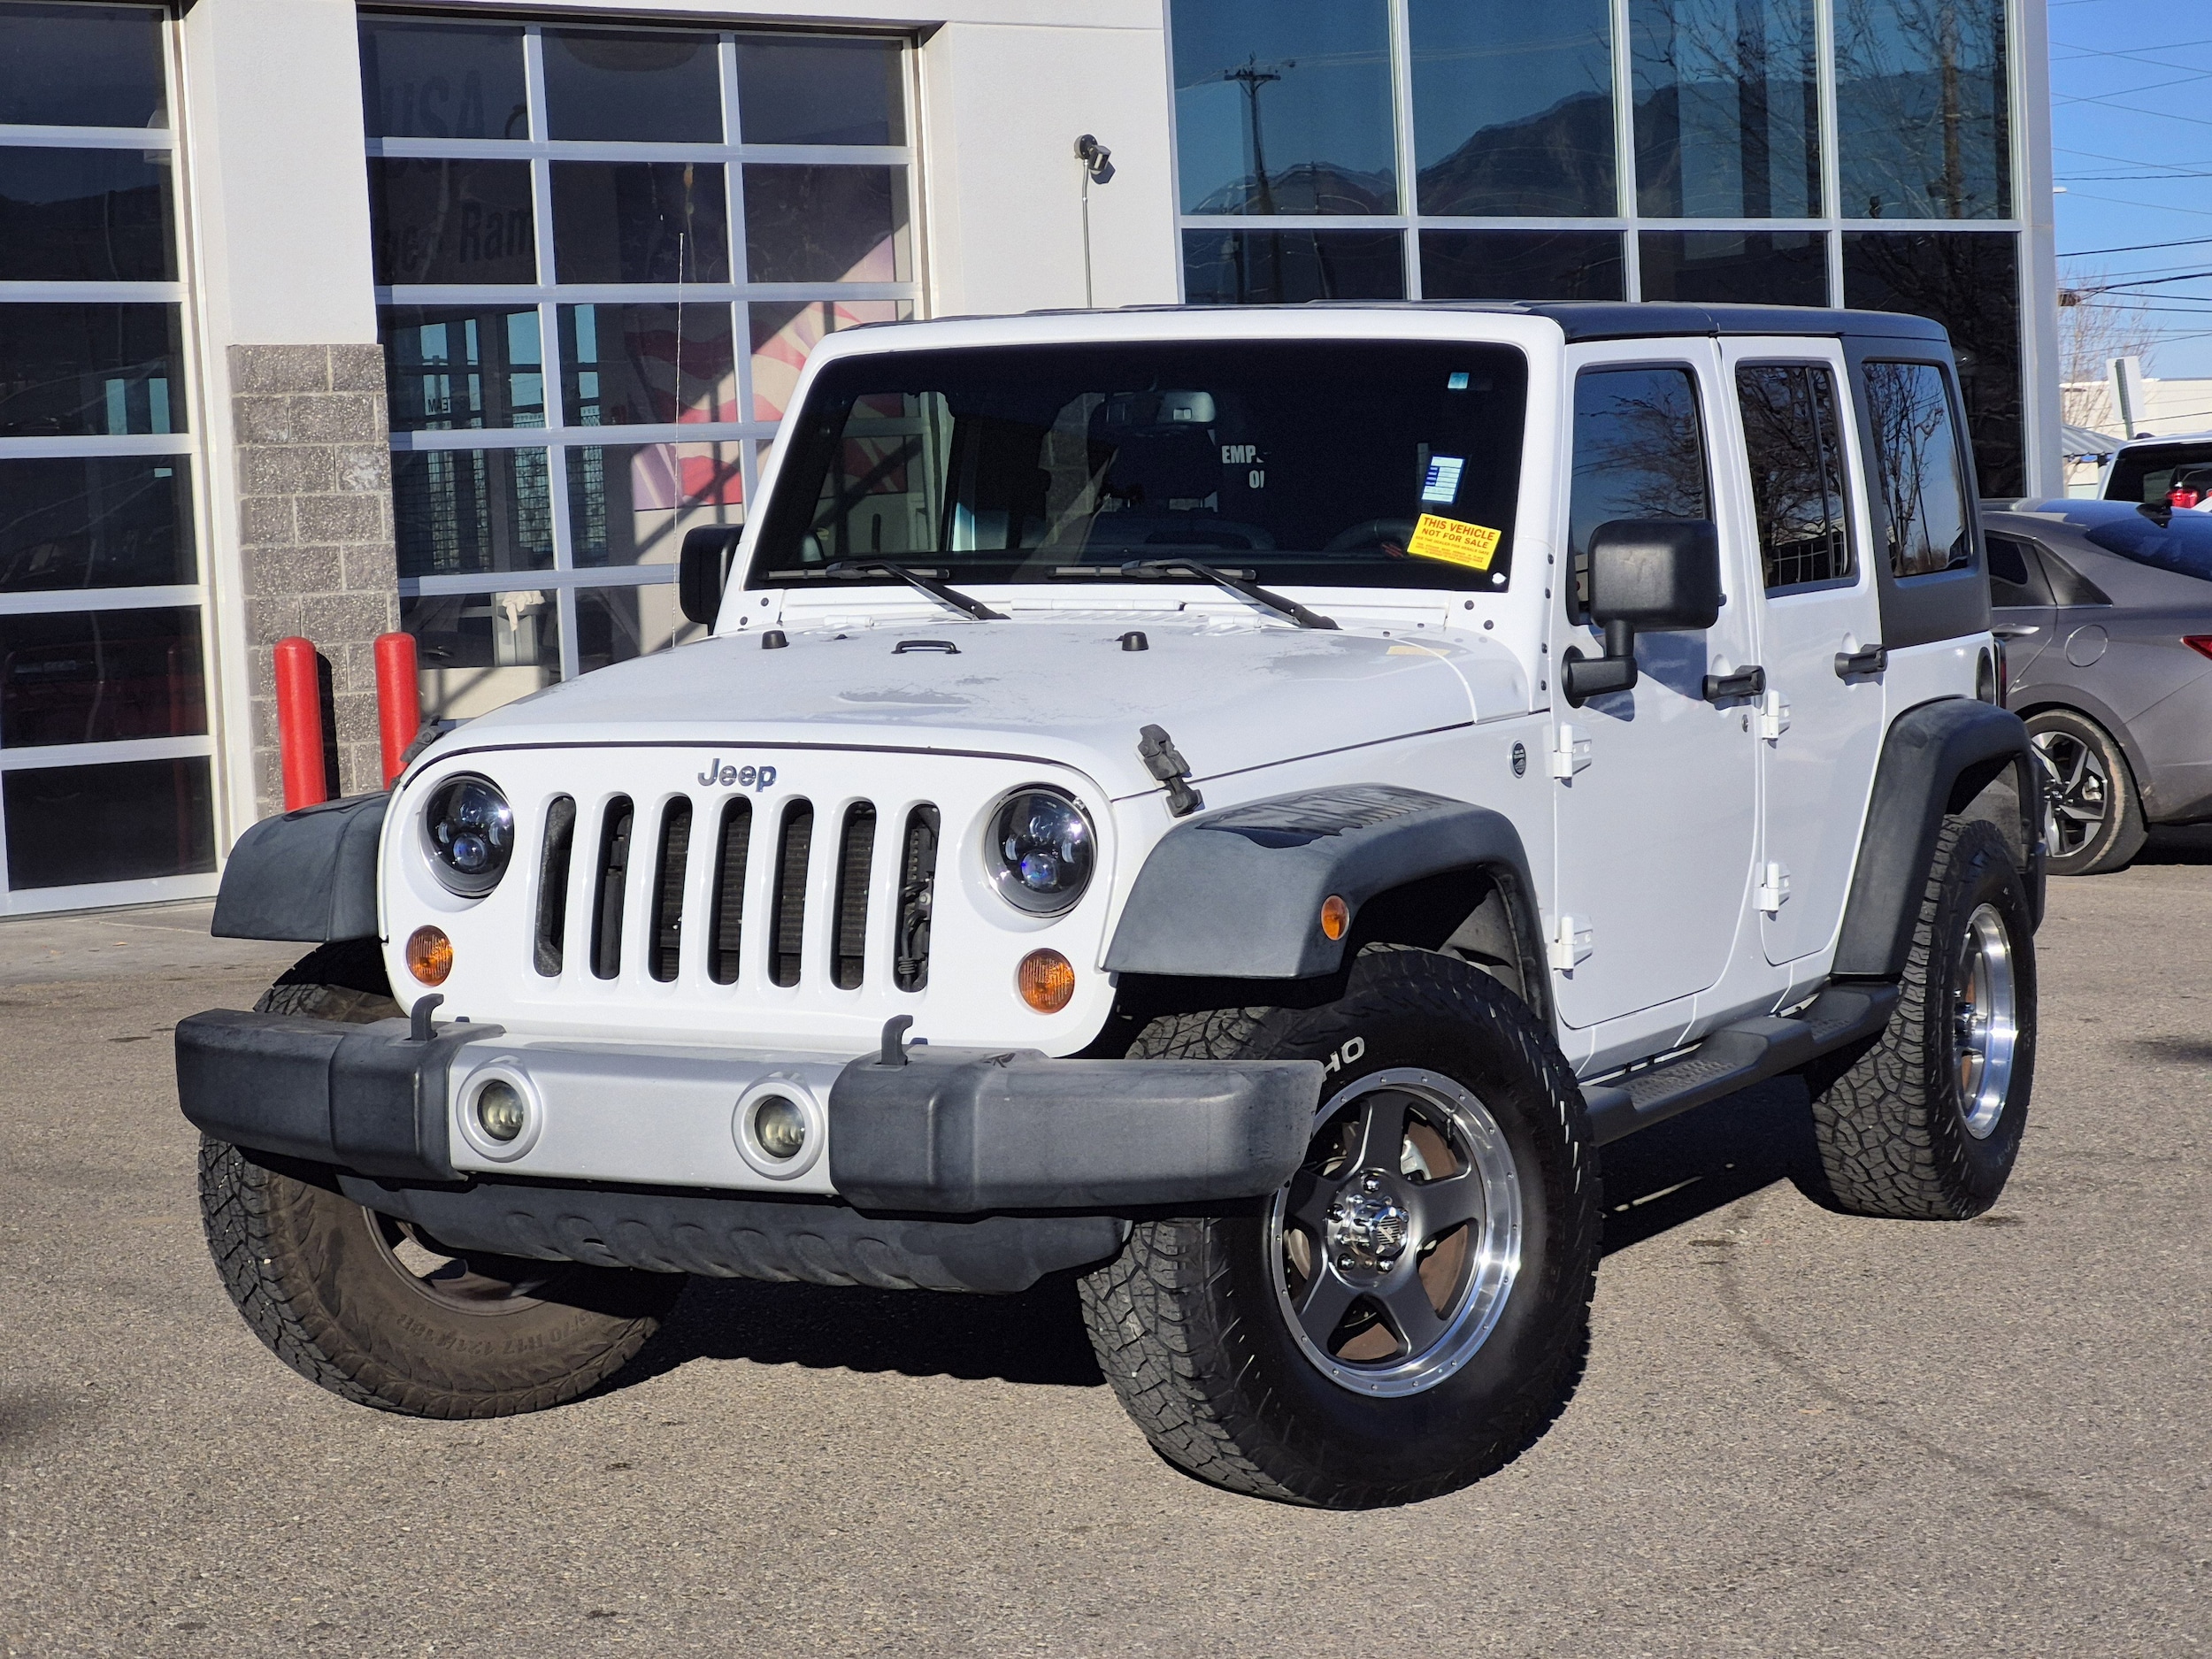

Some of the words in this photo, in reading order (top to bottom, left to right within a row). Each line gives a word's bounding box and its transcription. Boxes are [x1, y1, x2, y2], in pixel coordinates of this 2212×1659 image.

[459, 200, 533, 264] Ram
[1221, 444, 1265, 464] EMP
[1422, 528, 1440, 537] NOT
[1442, 533, 1462, 542] FOR
[1464, 537, 1489, 549] SALE
[1424, 517, 1447, 530] THIS
[1450, 523, 1495, 541] VEHICLE
[697, 757, 777, 793] Jeep
